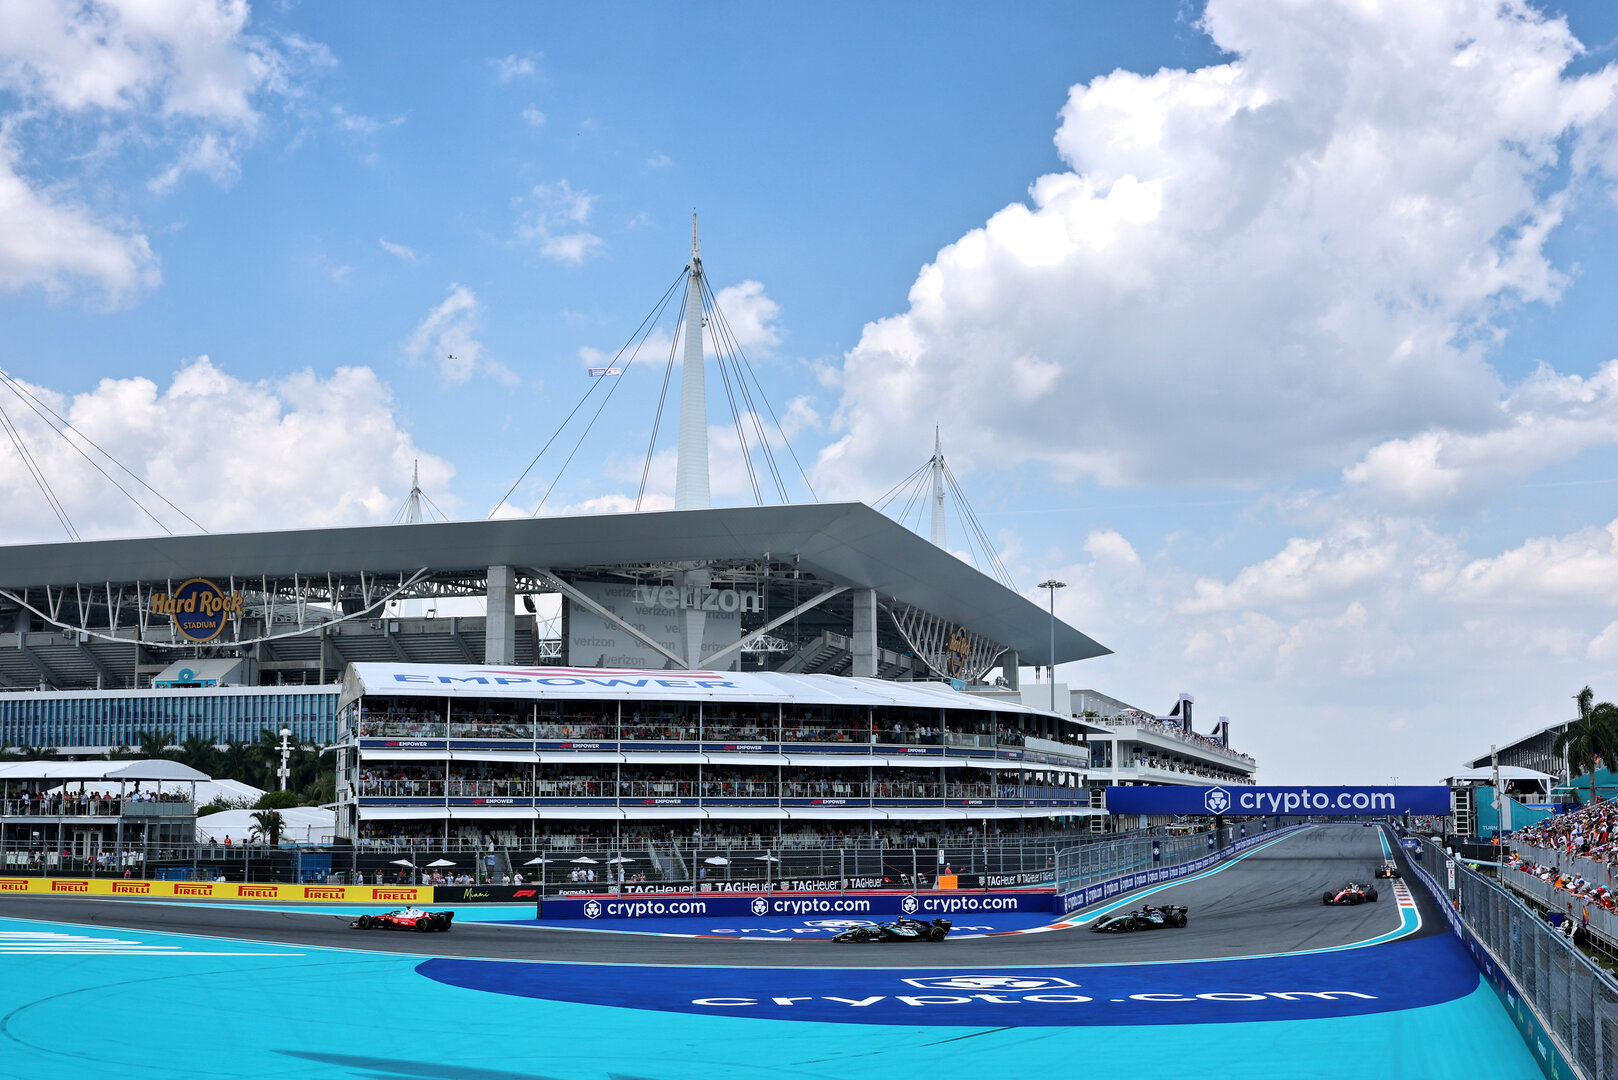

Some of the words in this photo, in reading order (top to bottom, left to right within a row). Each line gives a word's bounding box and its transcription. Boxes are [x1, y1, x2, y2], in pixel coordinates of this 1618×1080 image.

[152, 592, 197, 614] Hard
[200, 590, 244, 617] Rock
[640, 585, 760, 613] verizon
[183, 621, 217, 629] STADIUM
[574, 636, 616, 647] verizon
[606, 654, 645, 666] verizon
[393, 674, 741, 689] EMPOWER
[1240, 789, 1395, 813] crypto.com
[52, 881, 88, 891] PIRELLI
[792, 880, 839, 891] TAGHeuer
[850, 877, 882, 888] TAGHeuer
[987, 875, 1016, 886] TAGHeuer
[112, 882, 150, 893] PIRELLI
[174, 884, 213, 895] PIRELLI
[238, 886, 278, 897] PIRELLI
[716, 882, 777, 892] TAGHeuer
[304, 888, 345, 899] PIRELLI
[372, 889, 417, 900] PIRELLI
[463, 888, 490, 900] Miami
[607, 901, 706, 917] crypto.com
[774, 898, 870, 915] crypto.com
[924, 896, 1018, 912] crypto.com
[691, 991, 1378, 1007] crypto.com
